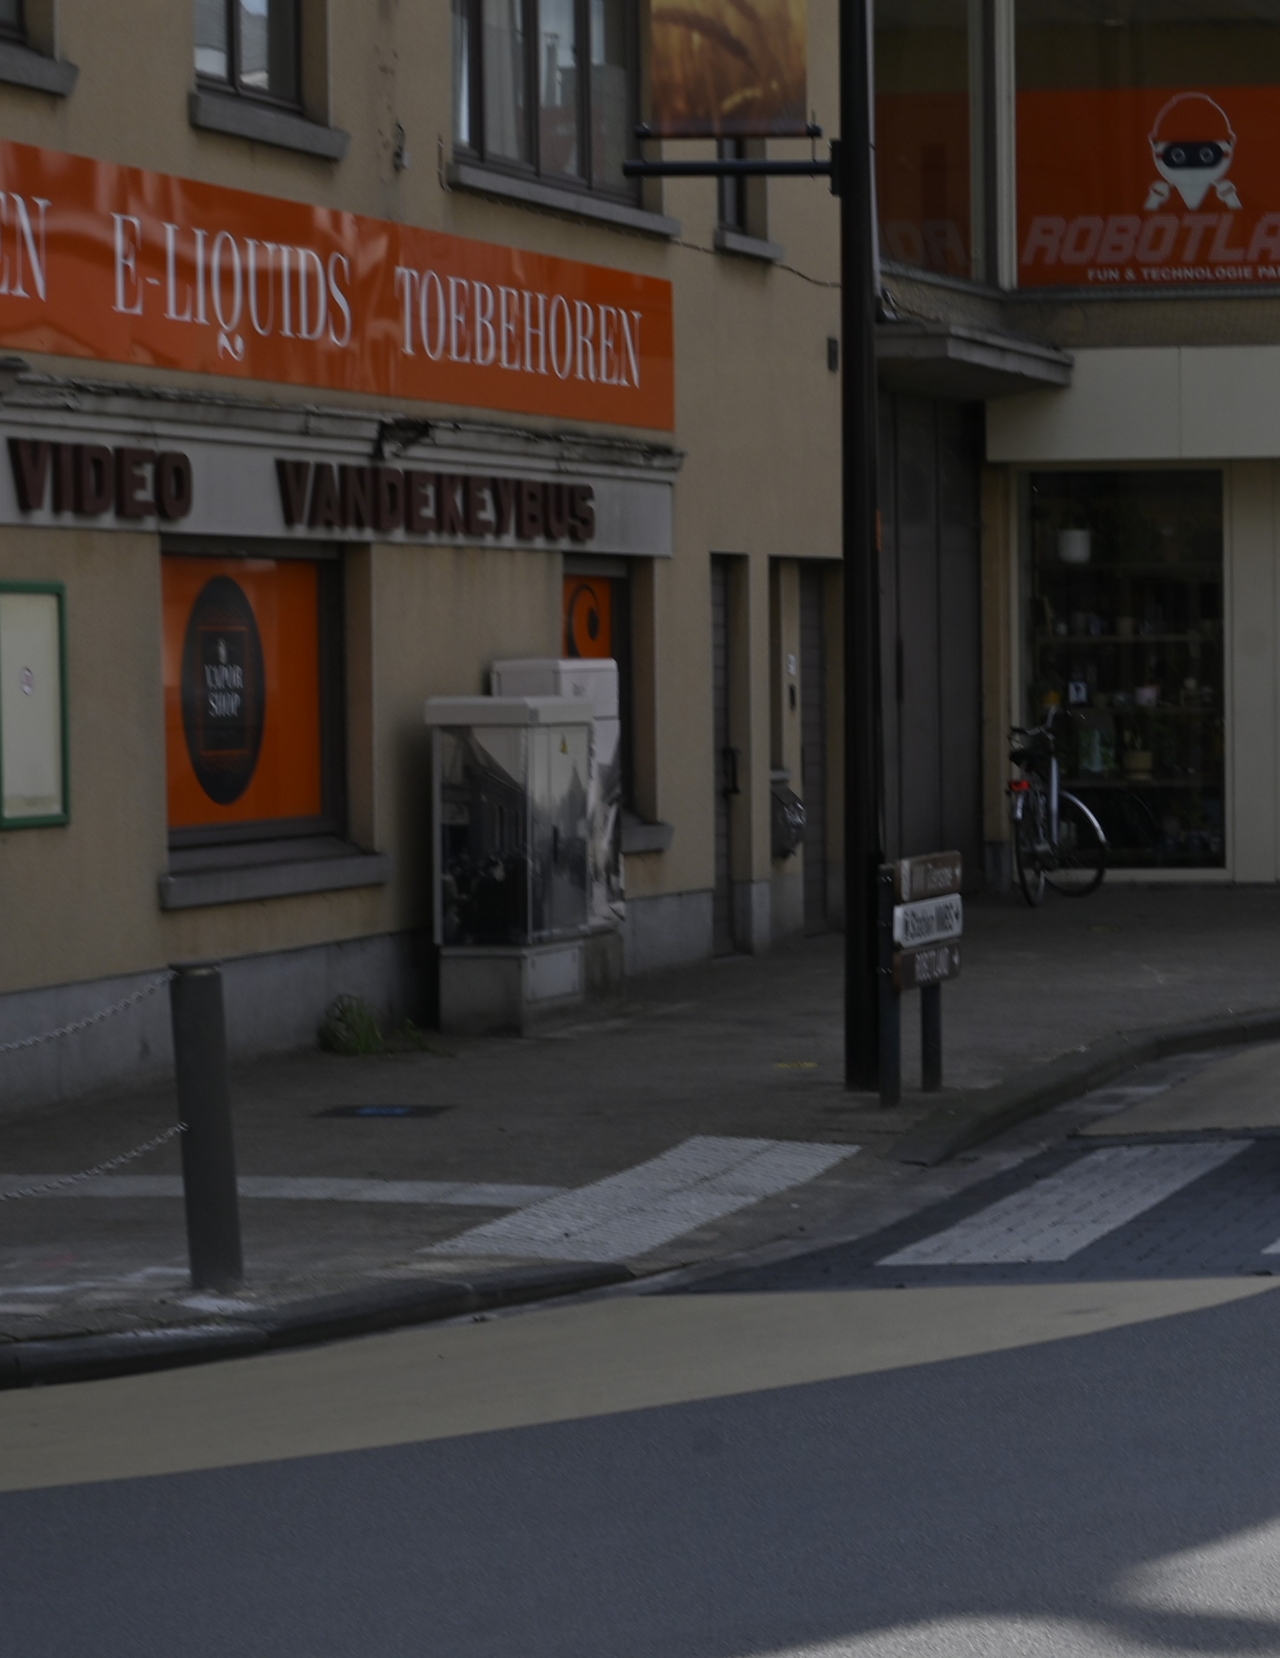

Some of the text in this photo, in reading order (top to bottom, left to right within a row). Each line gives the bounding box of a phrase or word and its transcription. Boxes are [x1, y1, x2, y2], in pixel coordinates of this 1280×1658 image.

[111, 211, 352, 362] E-LIQUIDS
[394, 265, 642, 389] TOEBEHOREN
[1088, 268, 1119, 281] FUN
[1125, 268, 1136, 280] &
[1141, 267, 1253, 280] TECHNOLOGIE
[7, 436, 596, 543] VIDEO VANDEKEYBUS
